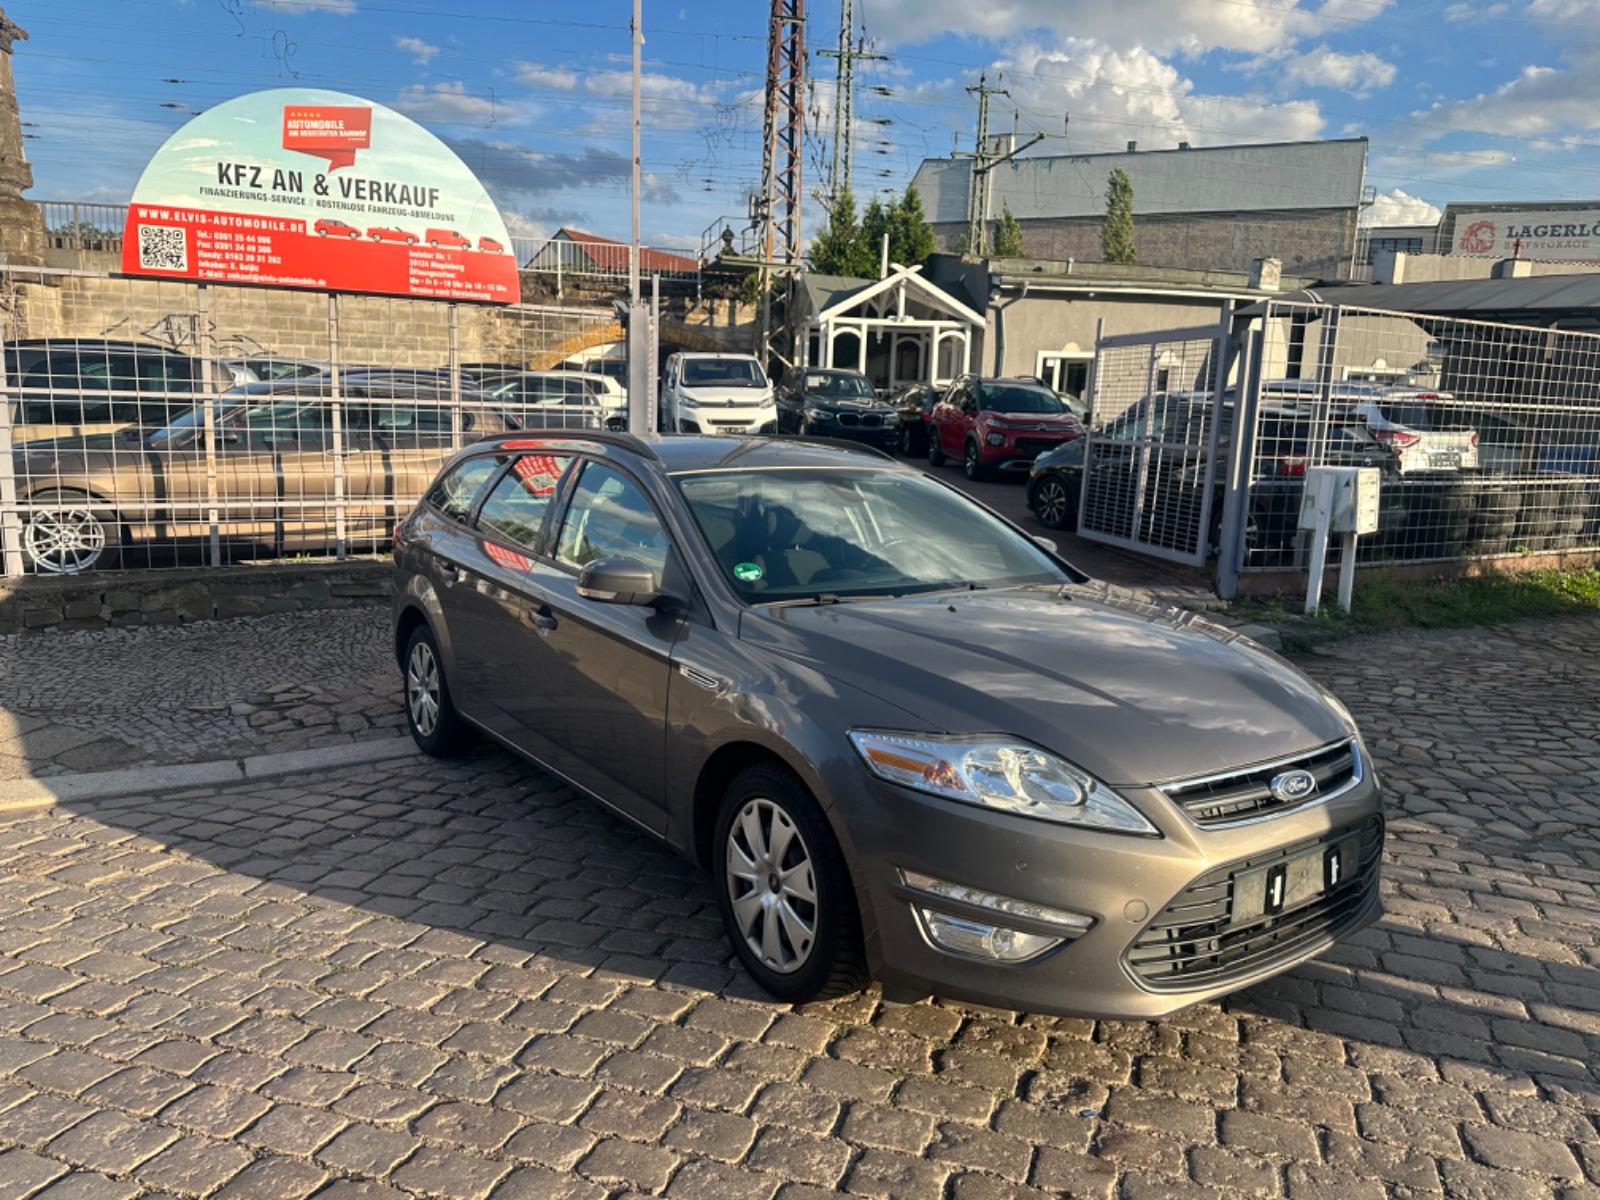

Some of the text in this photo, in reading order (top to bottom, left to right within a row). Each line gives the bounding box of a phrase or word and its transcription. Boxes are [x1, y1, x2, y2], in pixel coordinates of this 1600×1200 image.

[287, 119, 345, 129] AUTOMOBILE
[217, 162, 440, 208] KFZ AN & VERKAUF
[199, 186, 306, 206] FINANZIERUNGS-SERVICE
[316, 199, 365, 213] KOSTENLOSE
[367, 204, 456, 222] FAHRZEUG-ABMELDUNG
[137, 207, 305, 233] WWW.ELVIS-AUTOMOBILE.DE
[1281, 775, 1307, 793] Ford
